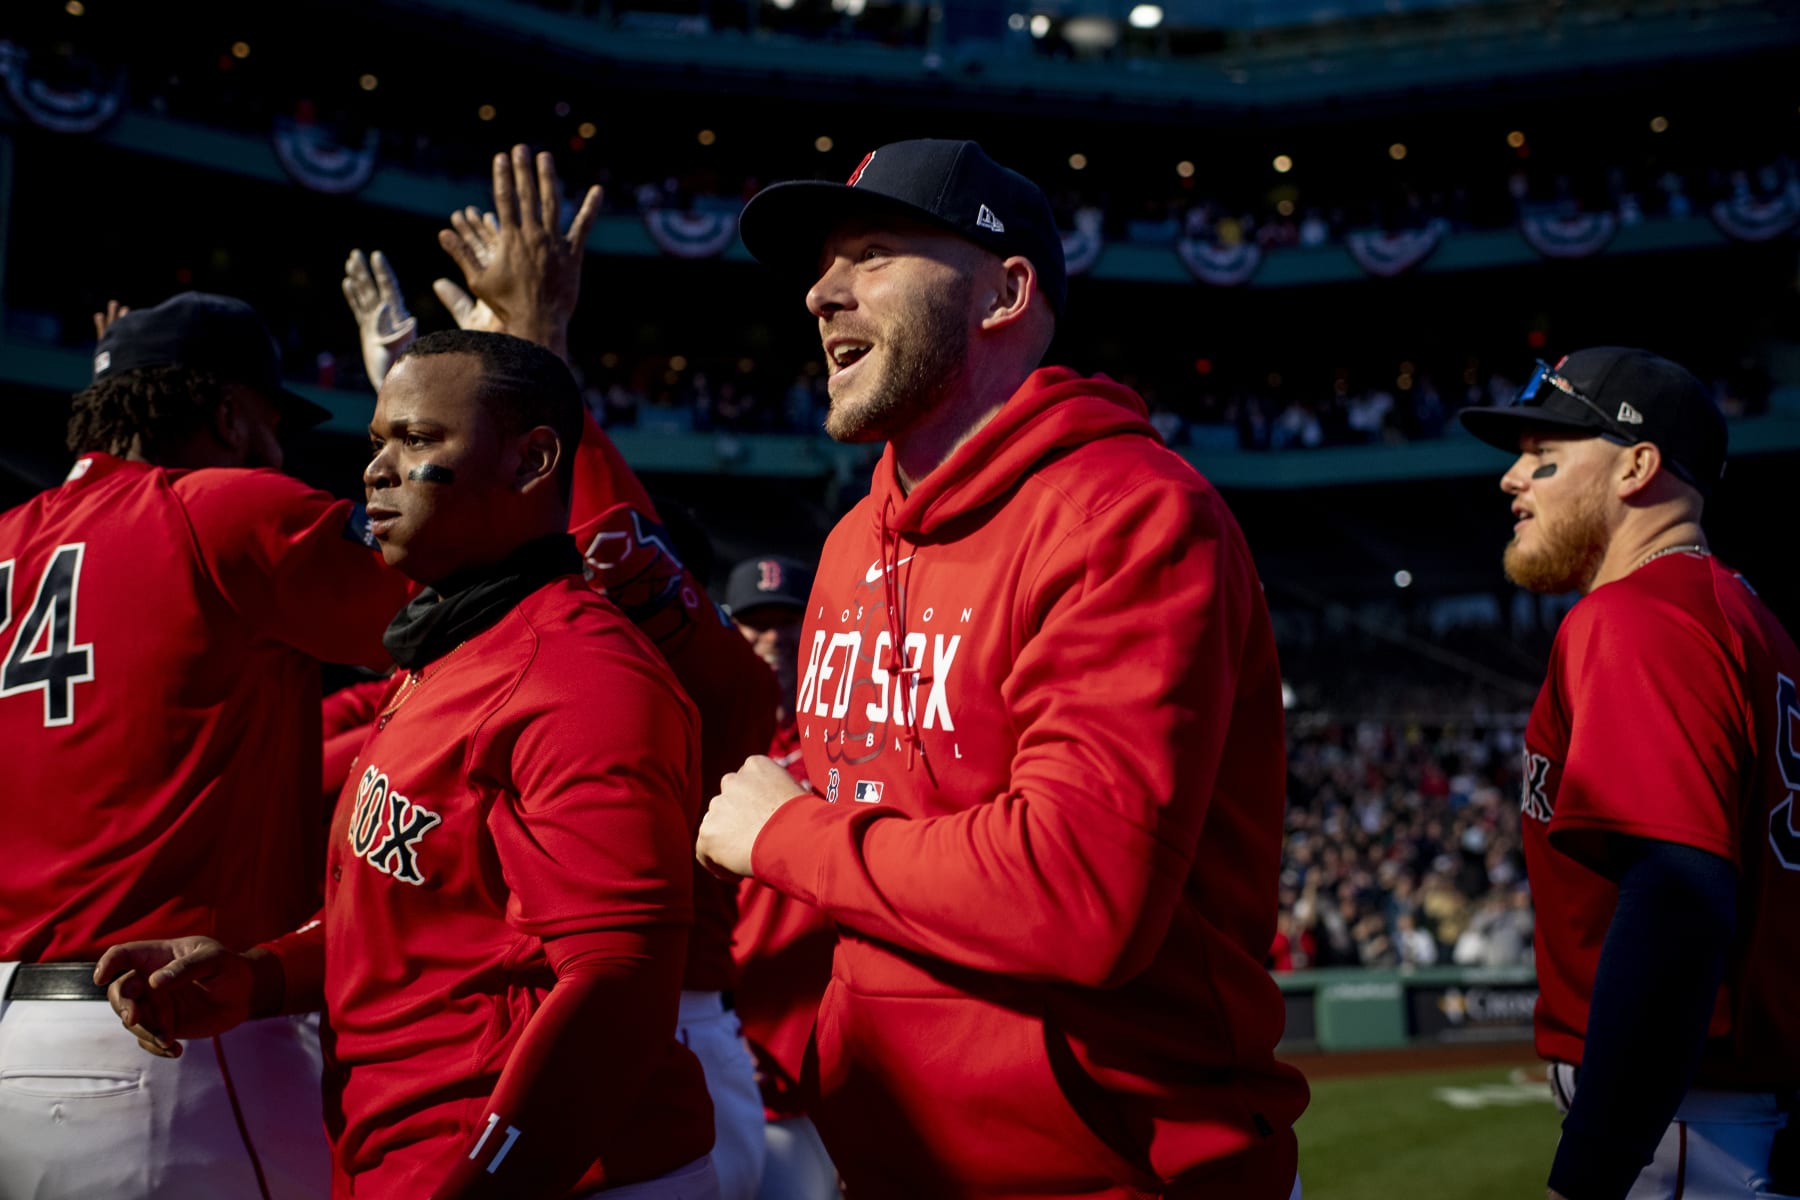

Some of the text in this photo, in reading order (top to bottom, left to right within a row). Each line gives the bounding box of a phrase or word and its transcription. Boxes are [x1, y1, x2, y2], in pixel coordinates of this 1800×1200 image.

[0, 541, 94, 727] 4
[796, 630, 962, 732] RED SOX
[468, 1112, 522, 1174] 11
